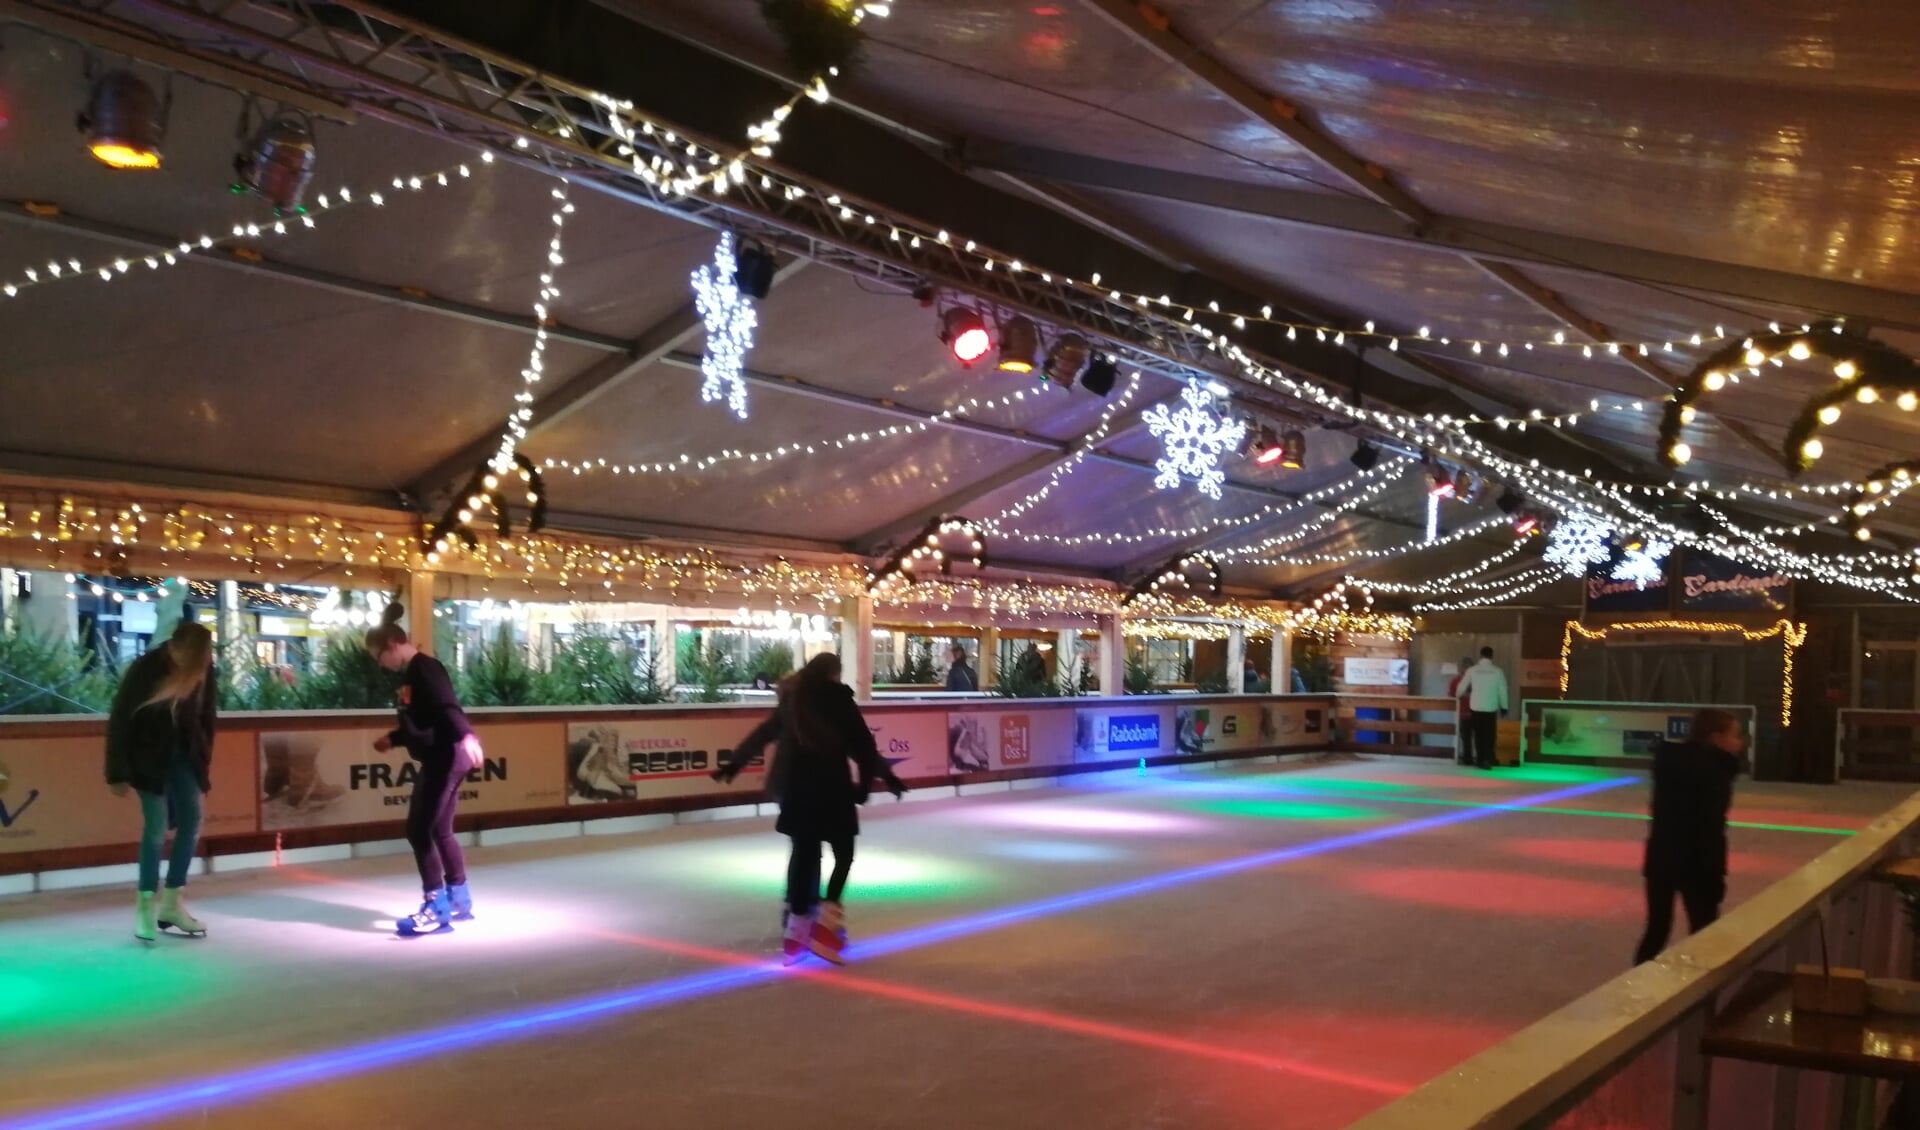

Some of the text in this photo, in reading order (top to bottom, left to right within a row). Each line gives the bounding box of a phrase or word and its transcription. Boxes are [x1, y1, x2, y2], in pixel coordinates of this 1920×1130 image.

[1111, 722, 1158, 743] Rabobank
[889, 738, 910, 752] Oss
[628, 750, 708, 774] REGIO
[350, 757, 508, 790] FRAEN
